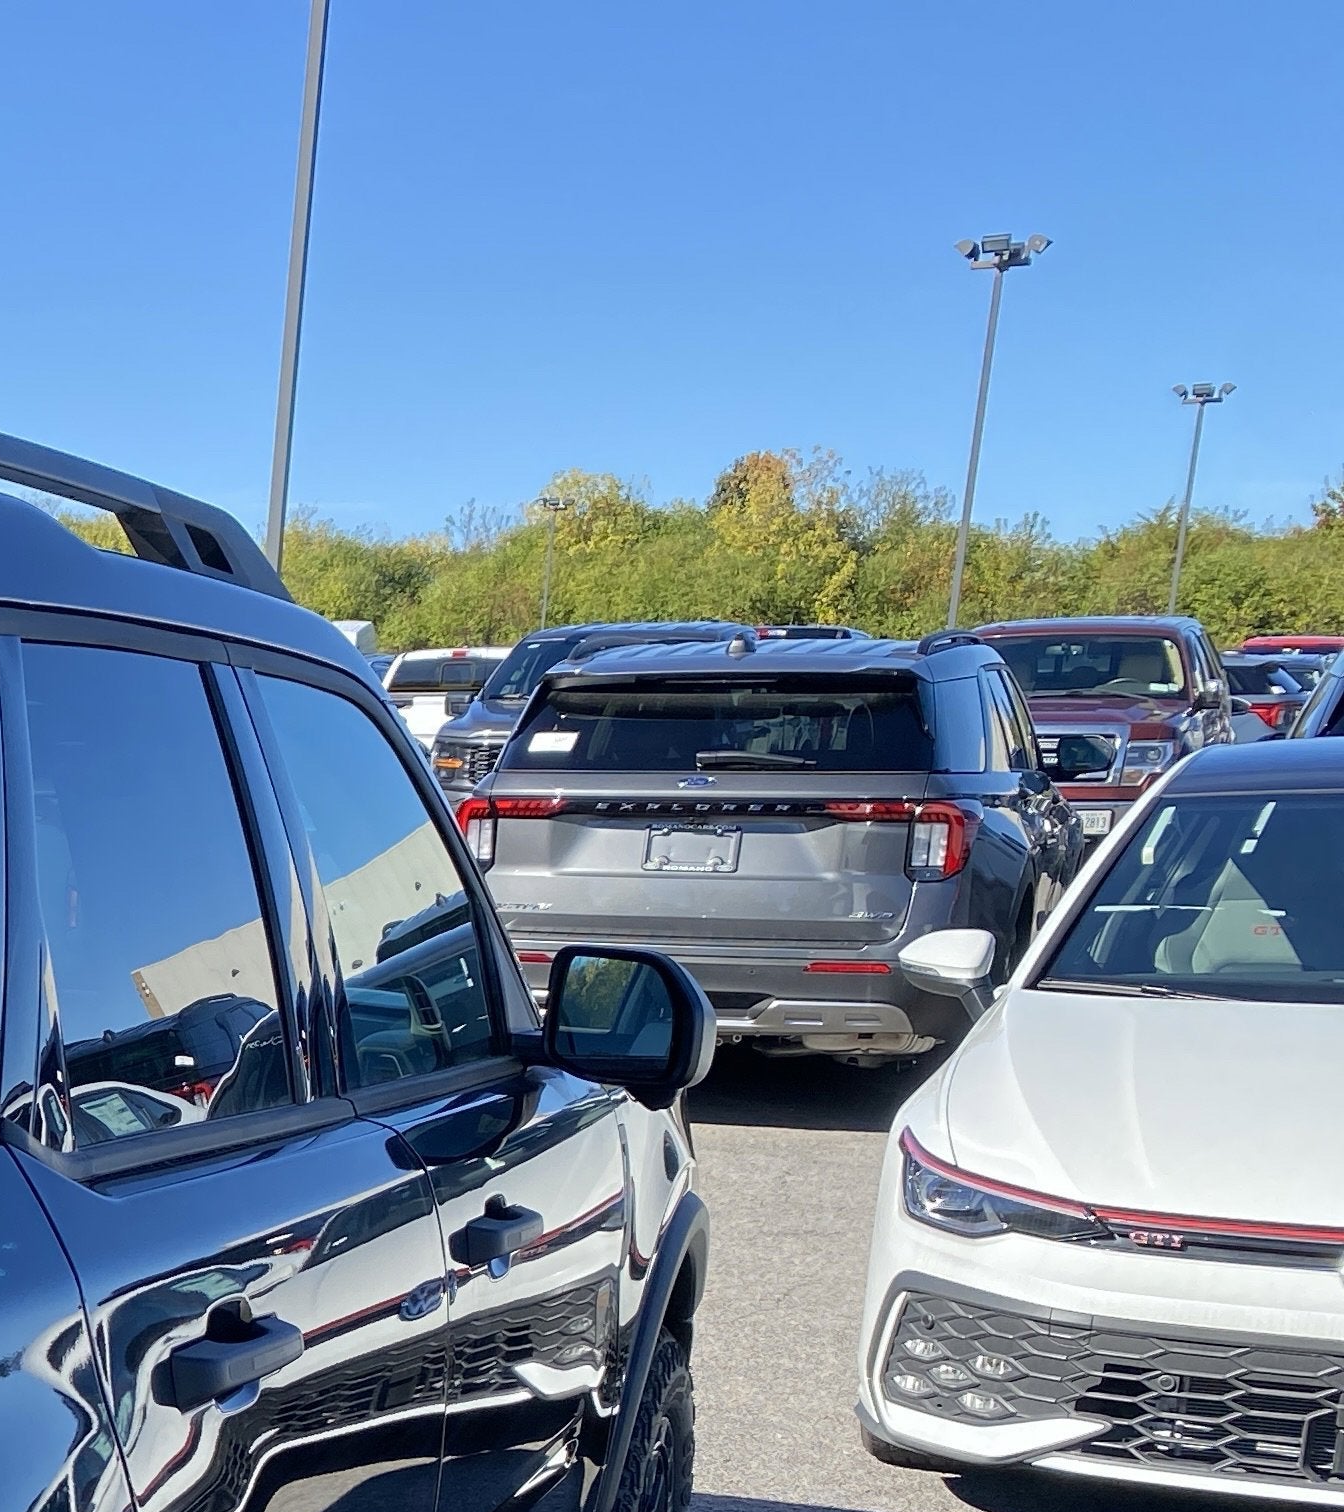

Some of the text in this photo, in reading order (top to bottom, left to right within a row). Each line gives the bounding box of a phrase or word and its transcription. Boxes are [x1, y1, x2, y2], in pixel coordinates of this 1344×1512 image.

[594, 801, 791, 812] EXPLORER
[662, 864, 714, 872] ROMANO
[1254, 925, 1281, 936] GT
[1129, 1230, 1185, 1249] GTI
